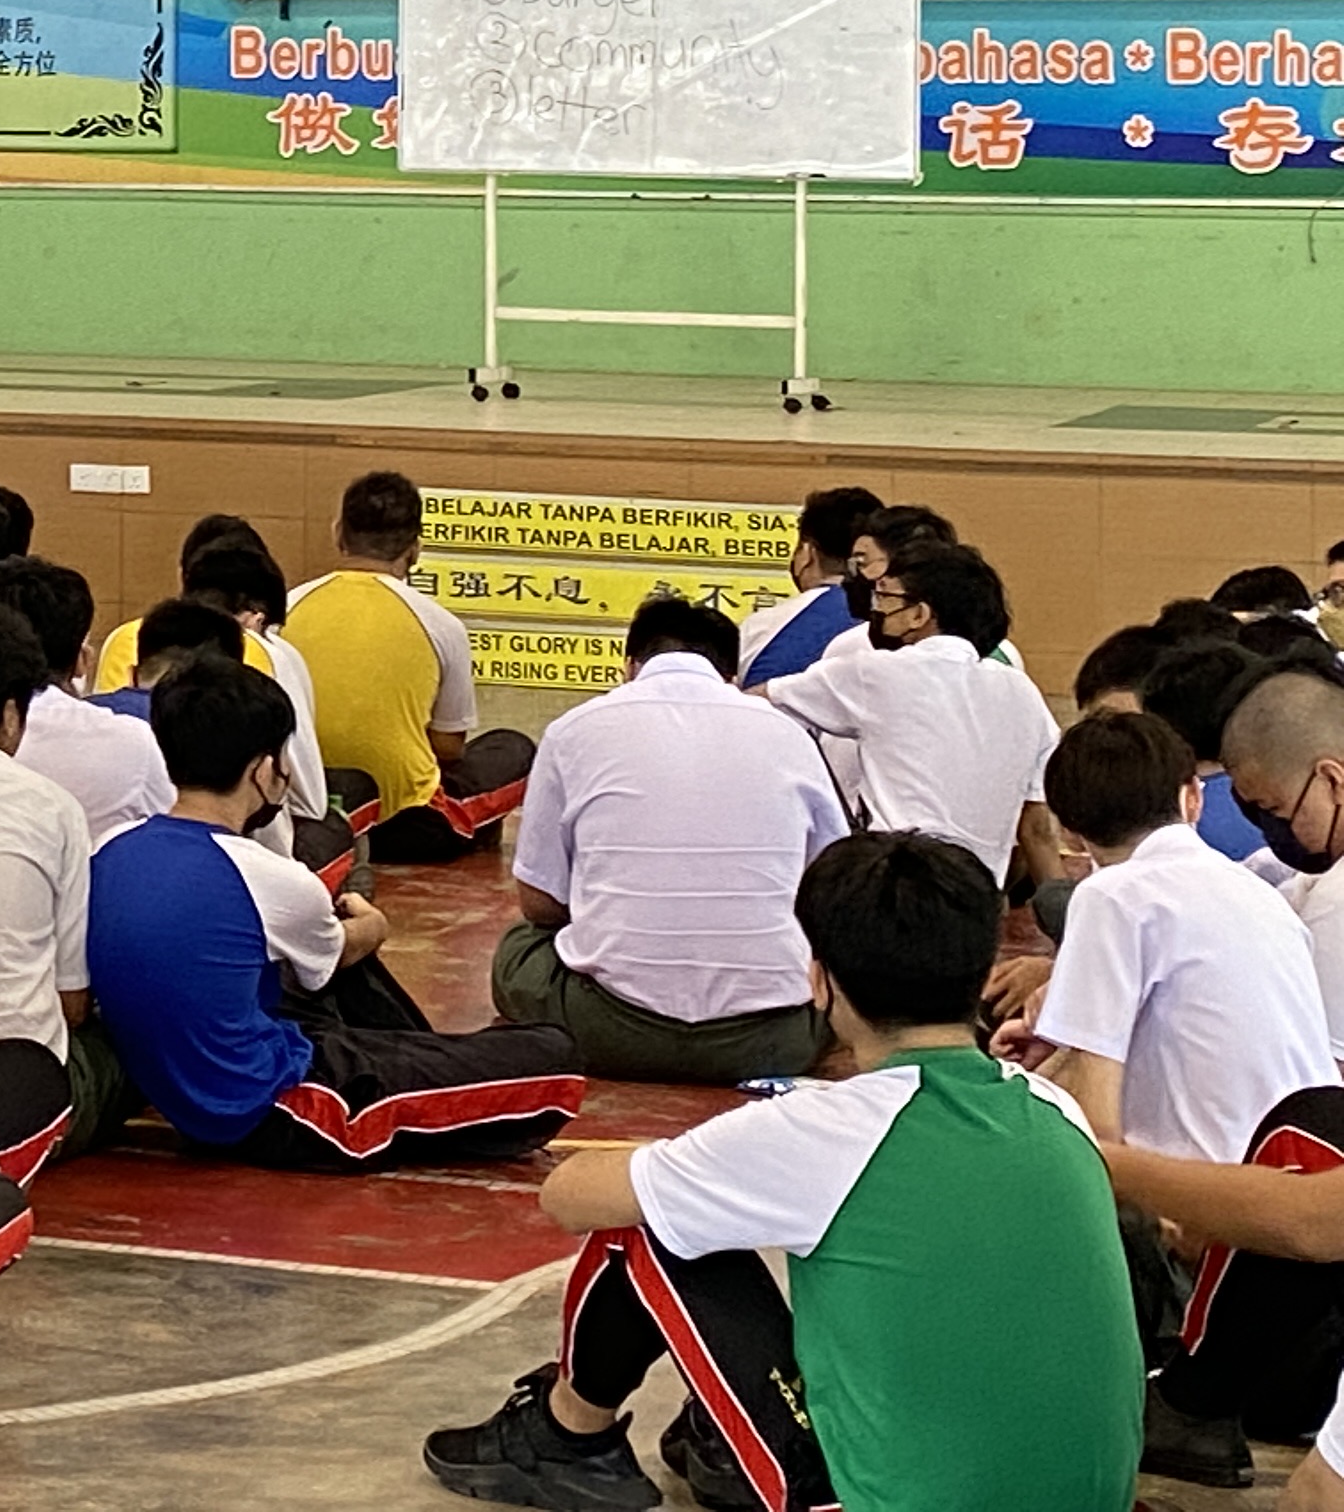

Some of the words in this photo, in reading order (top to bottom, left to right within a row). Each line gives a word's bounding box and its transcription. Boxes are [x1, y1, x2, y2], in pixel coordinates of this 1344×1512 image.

[939, 99, 1034, 170] 话
[425, 498, 531, 518] BELAJAR
[540, 503, 616, 522] TANPA
[520, 527, 592, 547] TANPA
[511, 636, 576, 655] GLORY
[584, 639, 603, 656] IS
[495, 662, 558, 680] RISING
